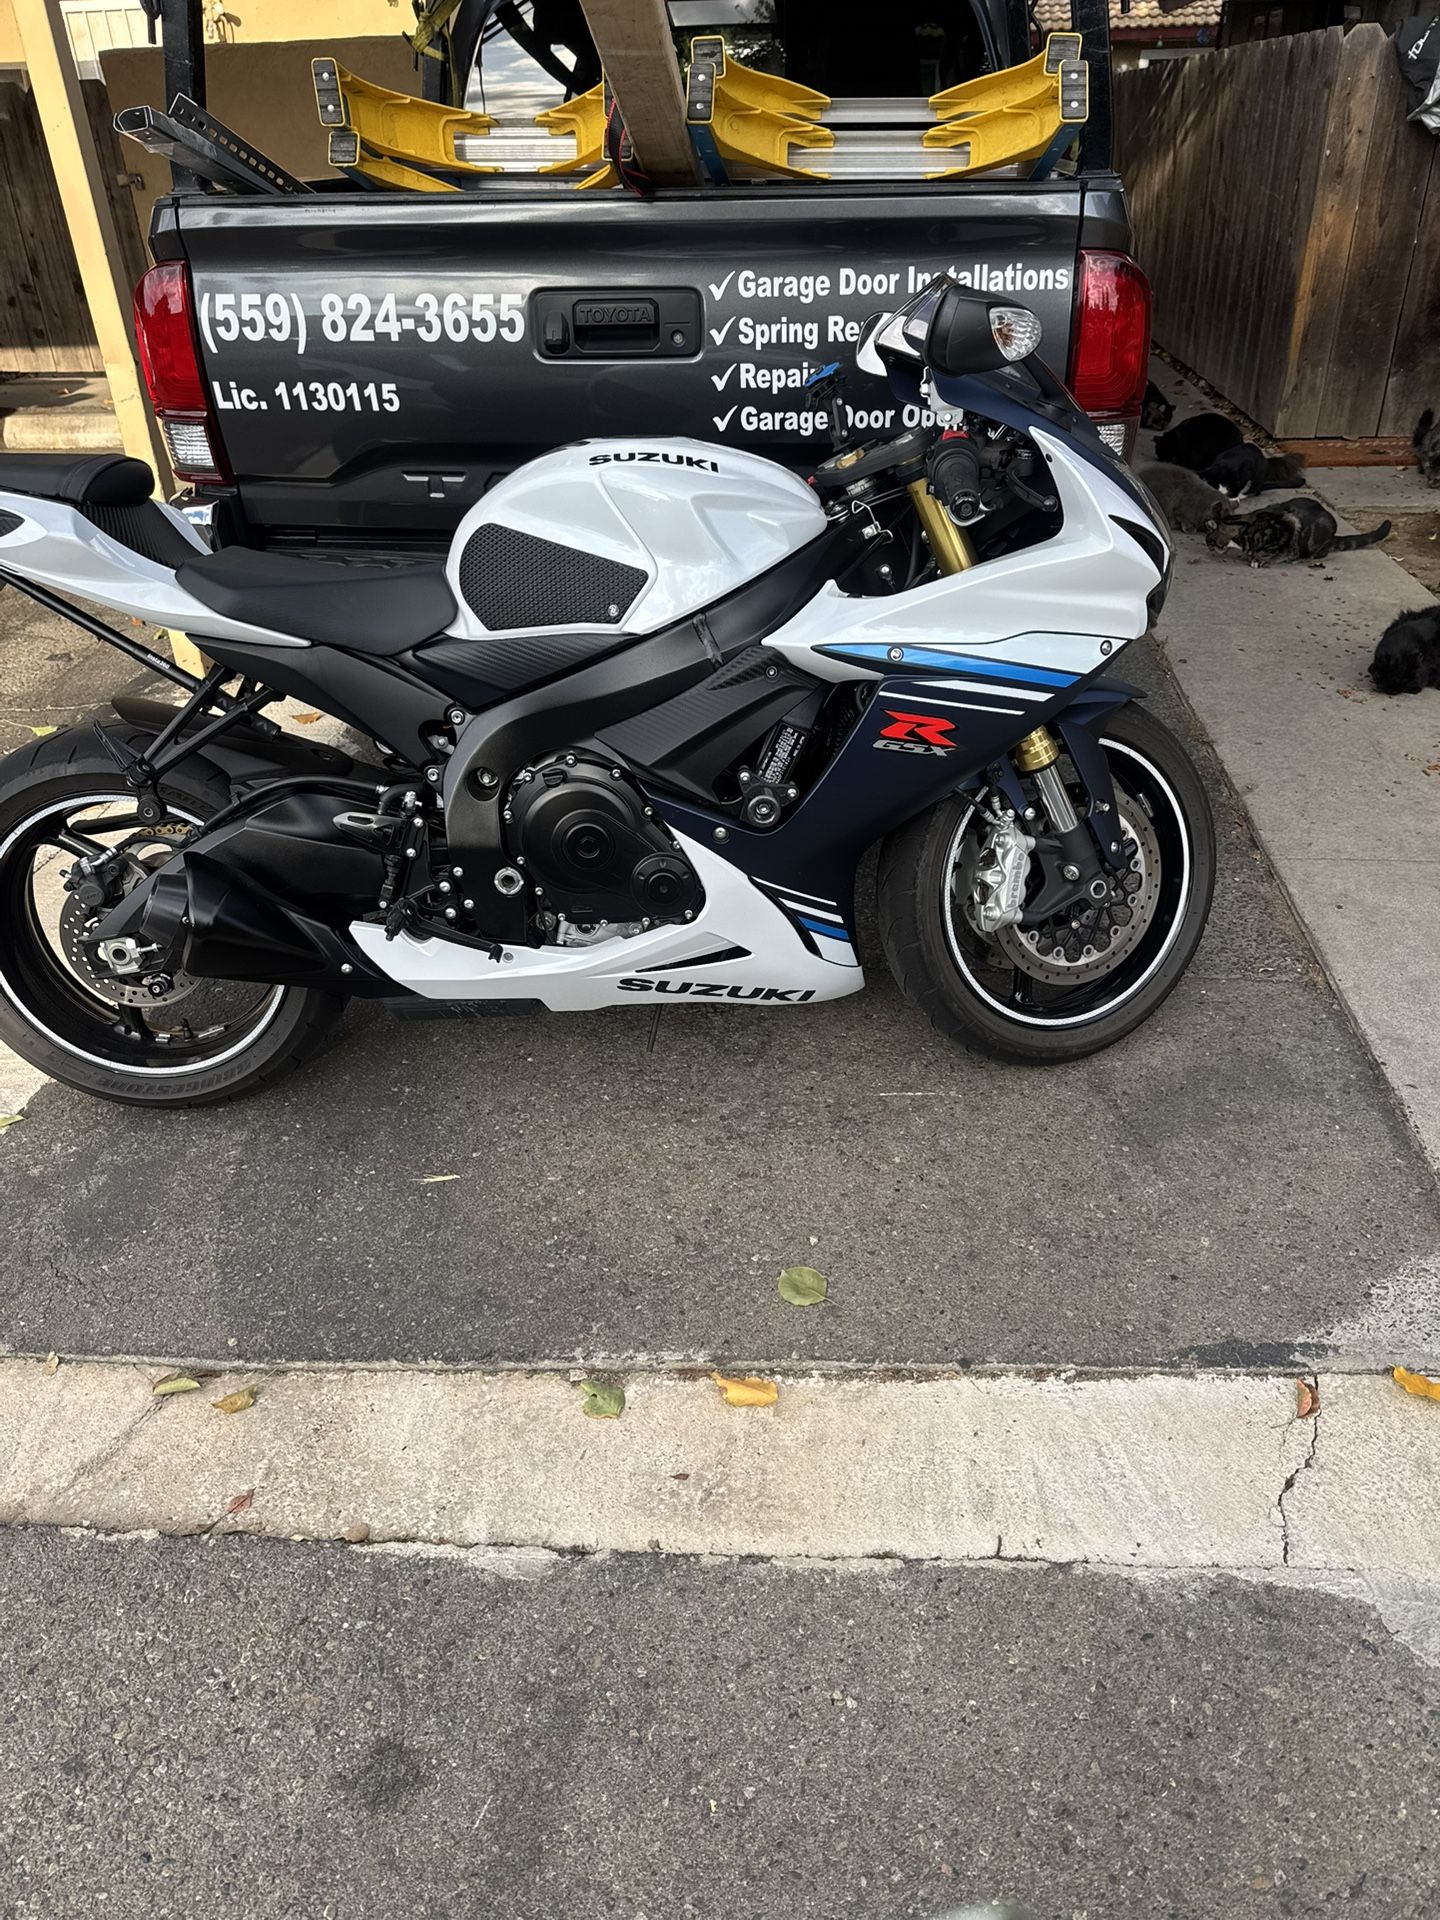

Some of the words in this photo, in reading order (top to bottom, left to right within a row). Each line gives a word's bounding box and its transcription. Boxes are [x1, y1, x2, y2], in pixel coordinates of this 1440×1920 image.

[737, 269, 831, 304] Garage
[839, 267, 900, 296] Door
[907, 262, 1069, 294] Intallations
[200, 292, 308, 354] (559)
[320, 292, 526, 343] 824-3655
[580, 306, 652, 324] TOYOTA
[738, 315, 819, 351] Spring
[739, 361, 817, 395] Repai
[212, 381, 269, 411] Lic.
[274, 381, 401, 413] 1130115
[740, 405, 829, 437] Garage
[588, 452, 719, 474] SUZUKI
[879, 709, 959, 748] R
[872, 739, 957, 757] GSX
[1006, 852, 1026, 909] brembo
[616, 977, 817, 1002] SUZUKI
